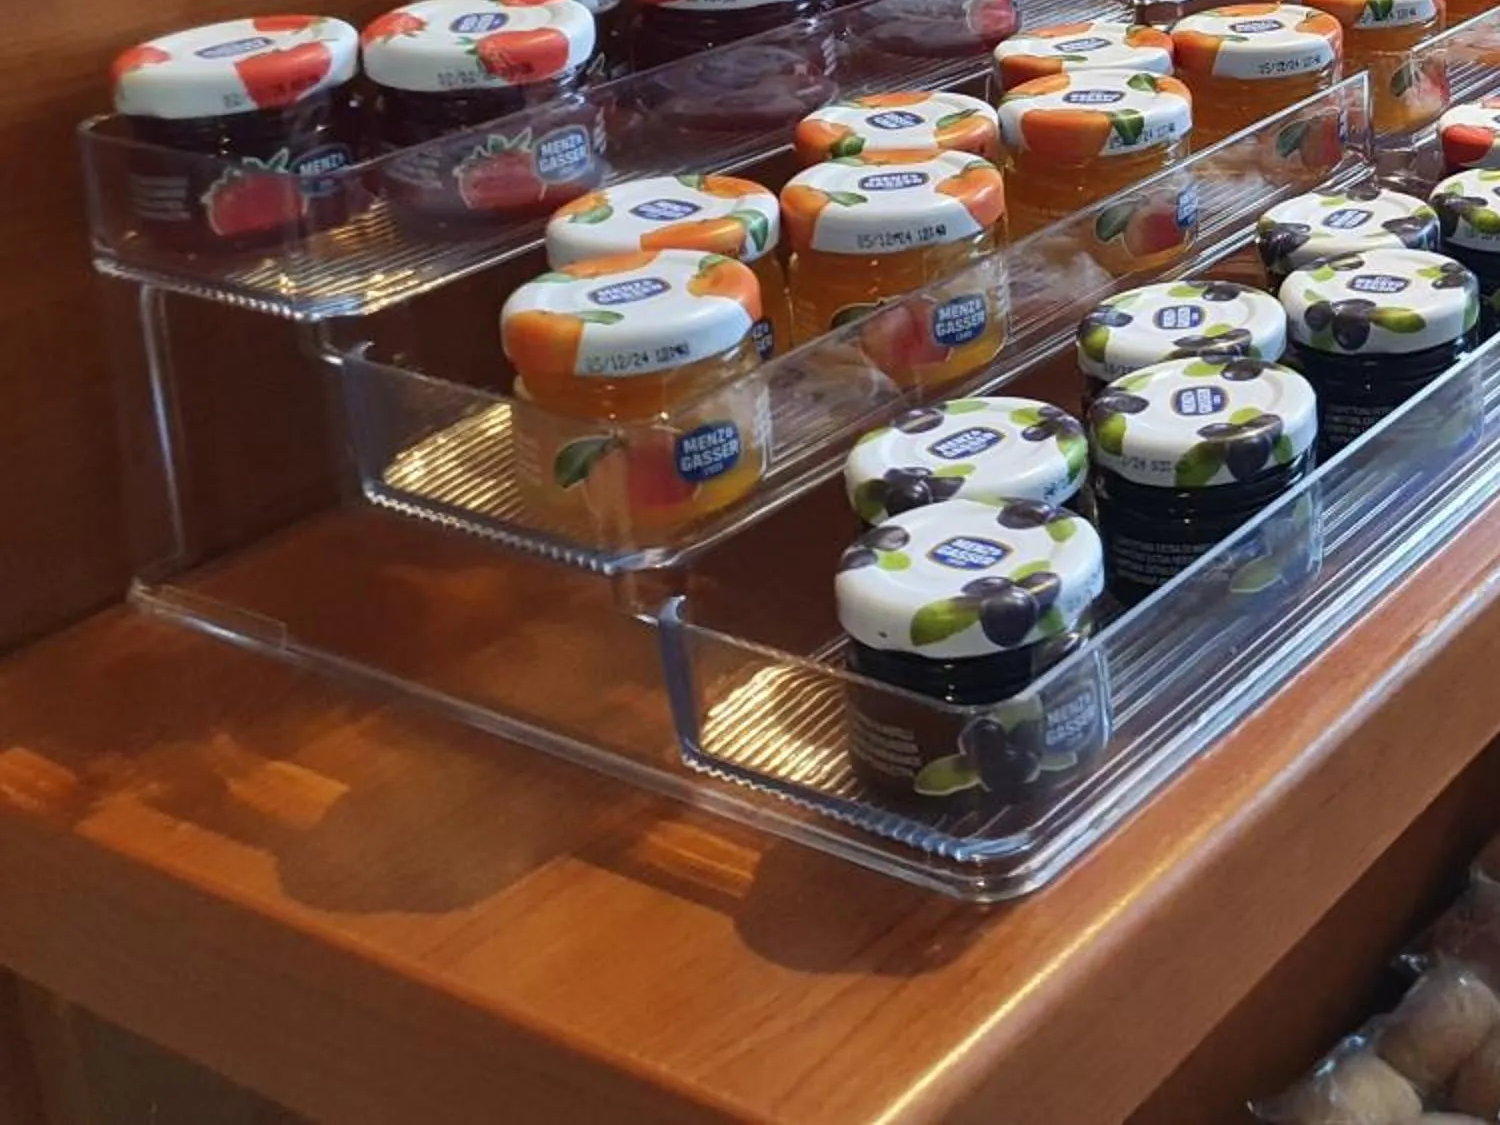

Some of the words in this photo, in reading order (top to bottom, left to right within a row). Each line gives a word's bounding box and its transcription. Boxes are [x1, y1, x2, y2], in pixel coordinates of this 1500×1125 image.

[539, 144, 586, 173] GASSER
[935, 310, 985, 338] GASSER
[680, 439, 740, 472] GASSER
